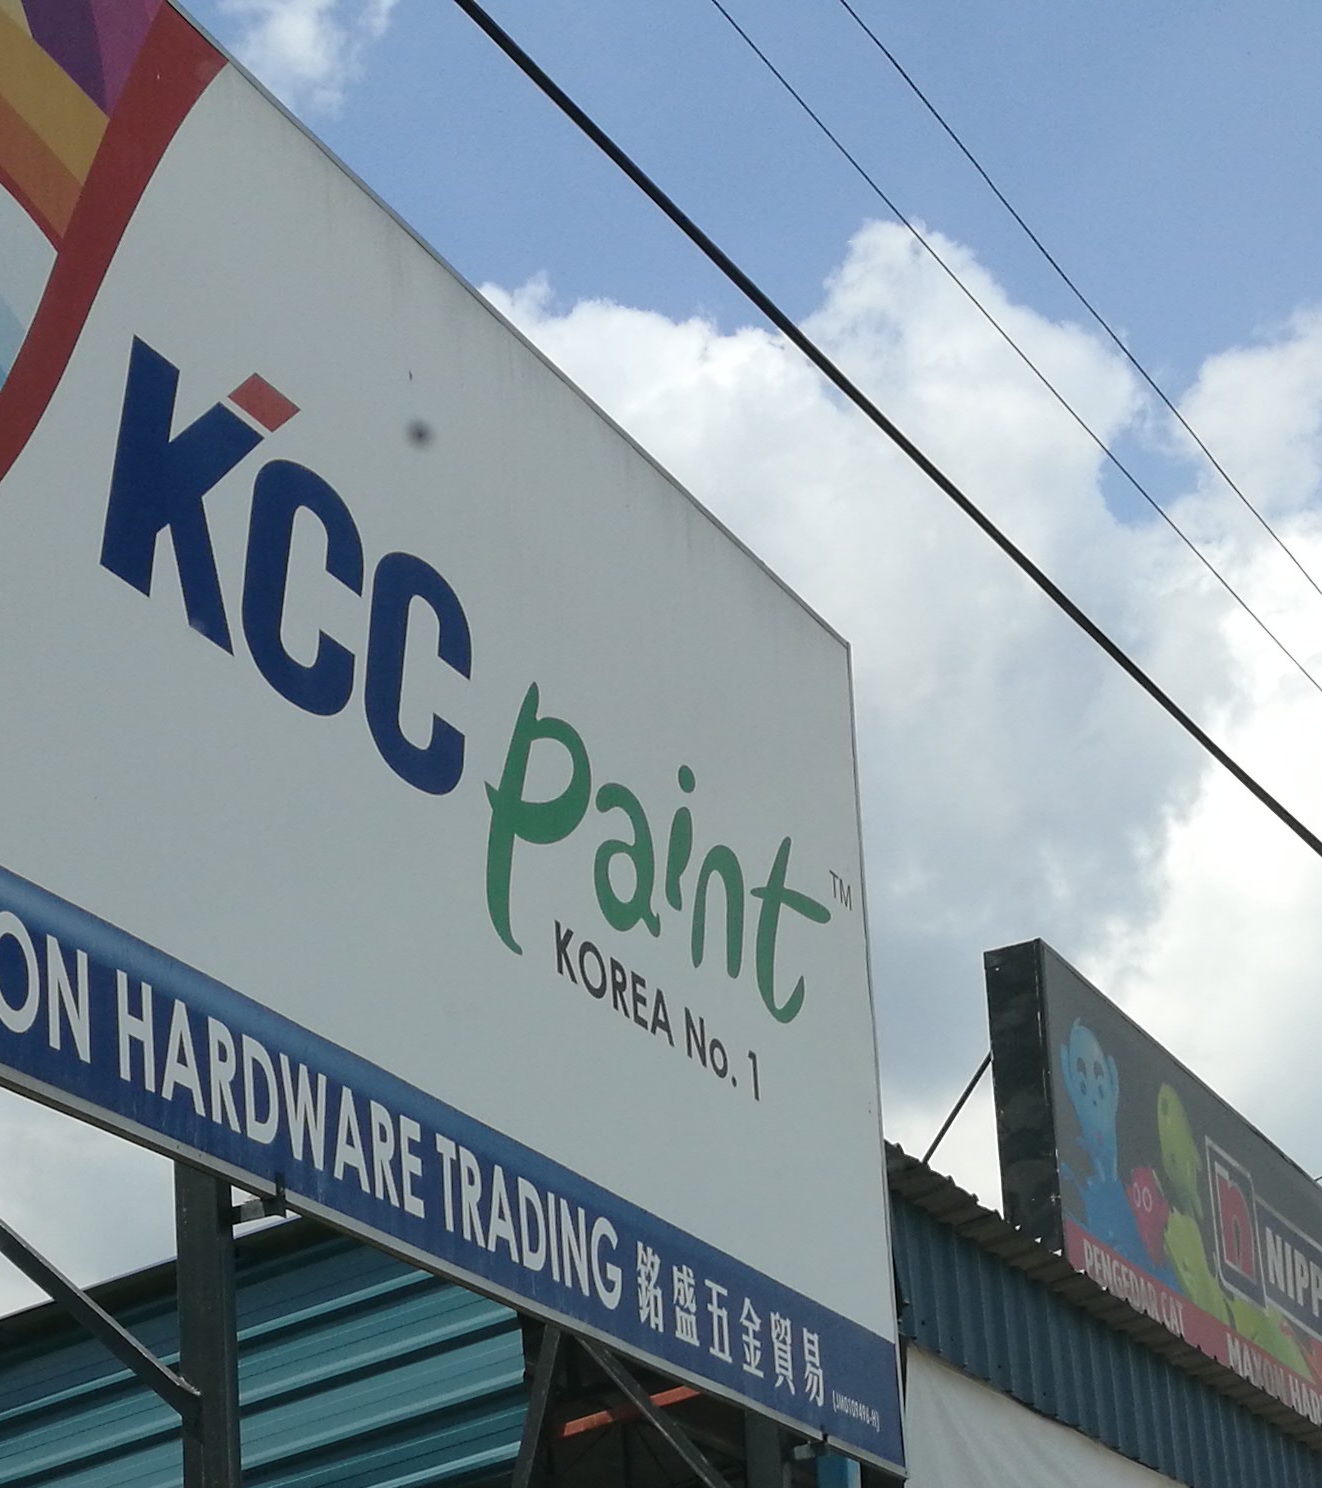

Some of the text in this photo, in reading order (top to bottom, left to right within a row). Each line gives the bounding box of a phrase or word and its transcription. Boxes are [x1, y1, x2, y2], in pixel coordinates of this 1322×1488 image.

[99, 333, 473, 797] KCC
[829, 870, 853, 911] TM
[554, 920, 763, 1102] KOREA No. 1
[116, 968, 425, 1219] HARDWARE
[435, 1132, 623, 1311] TRADING
[636, 1240, 825, 1408] 銘盛五金貿易
[1083, 1238, 1186, 1339] PENGEDAR CAT
[1227, 1332, 1289, 1408] MAXON
